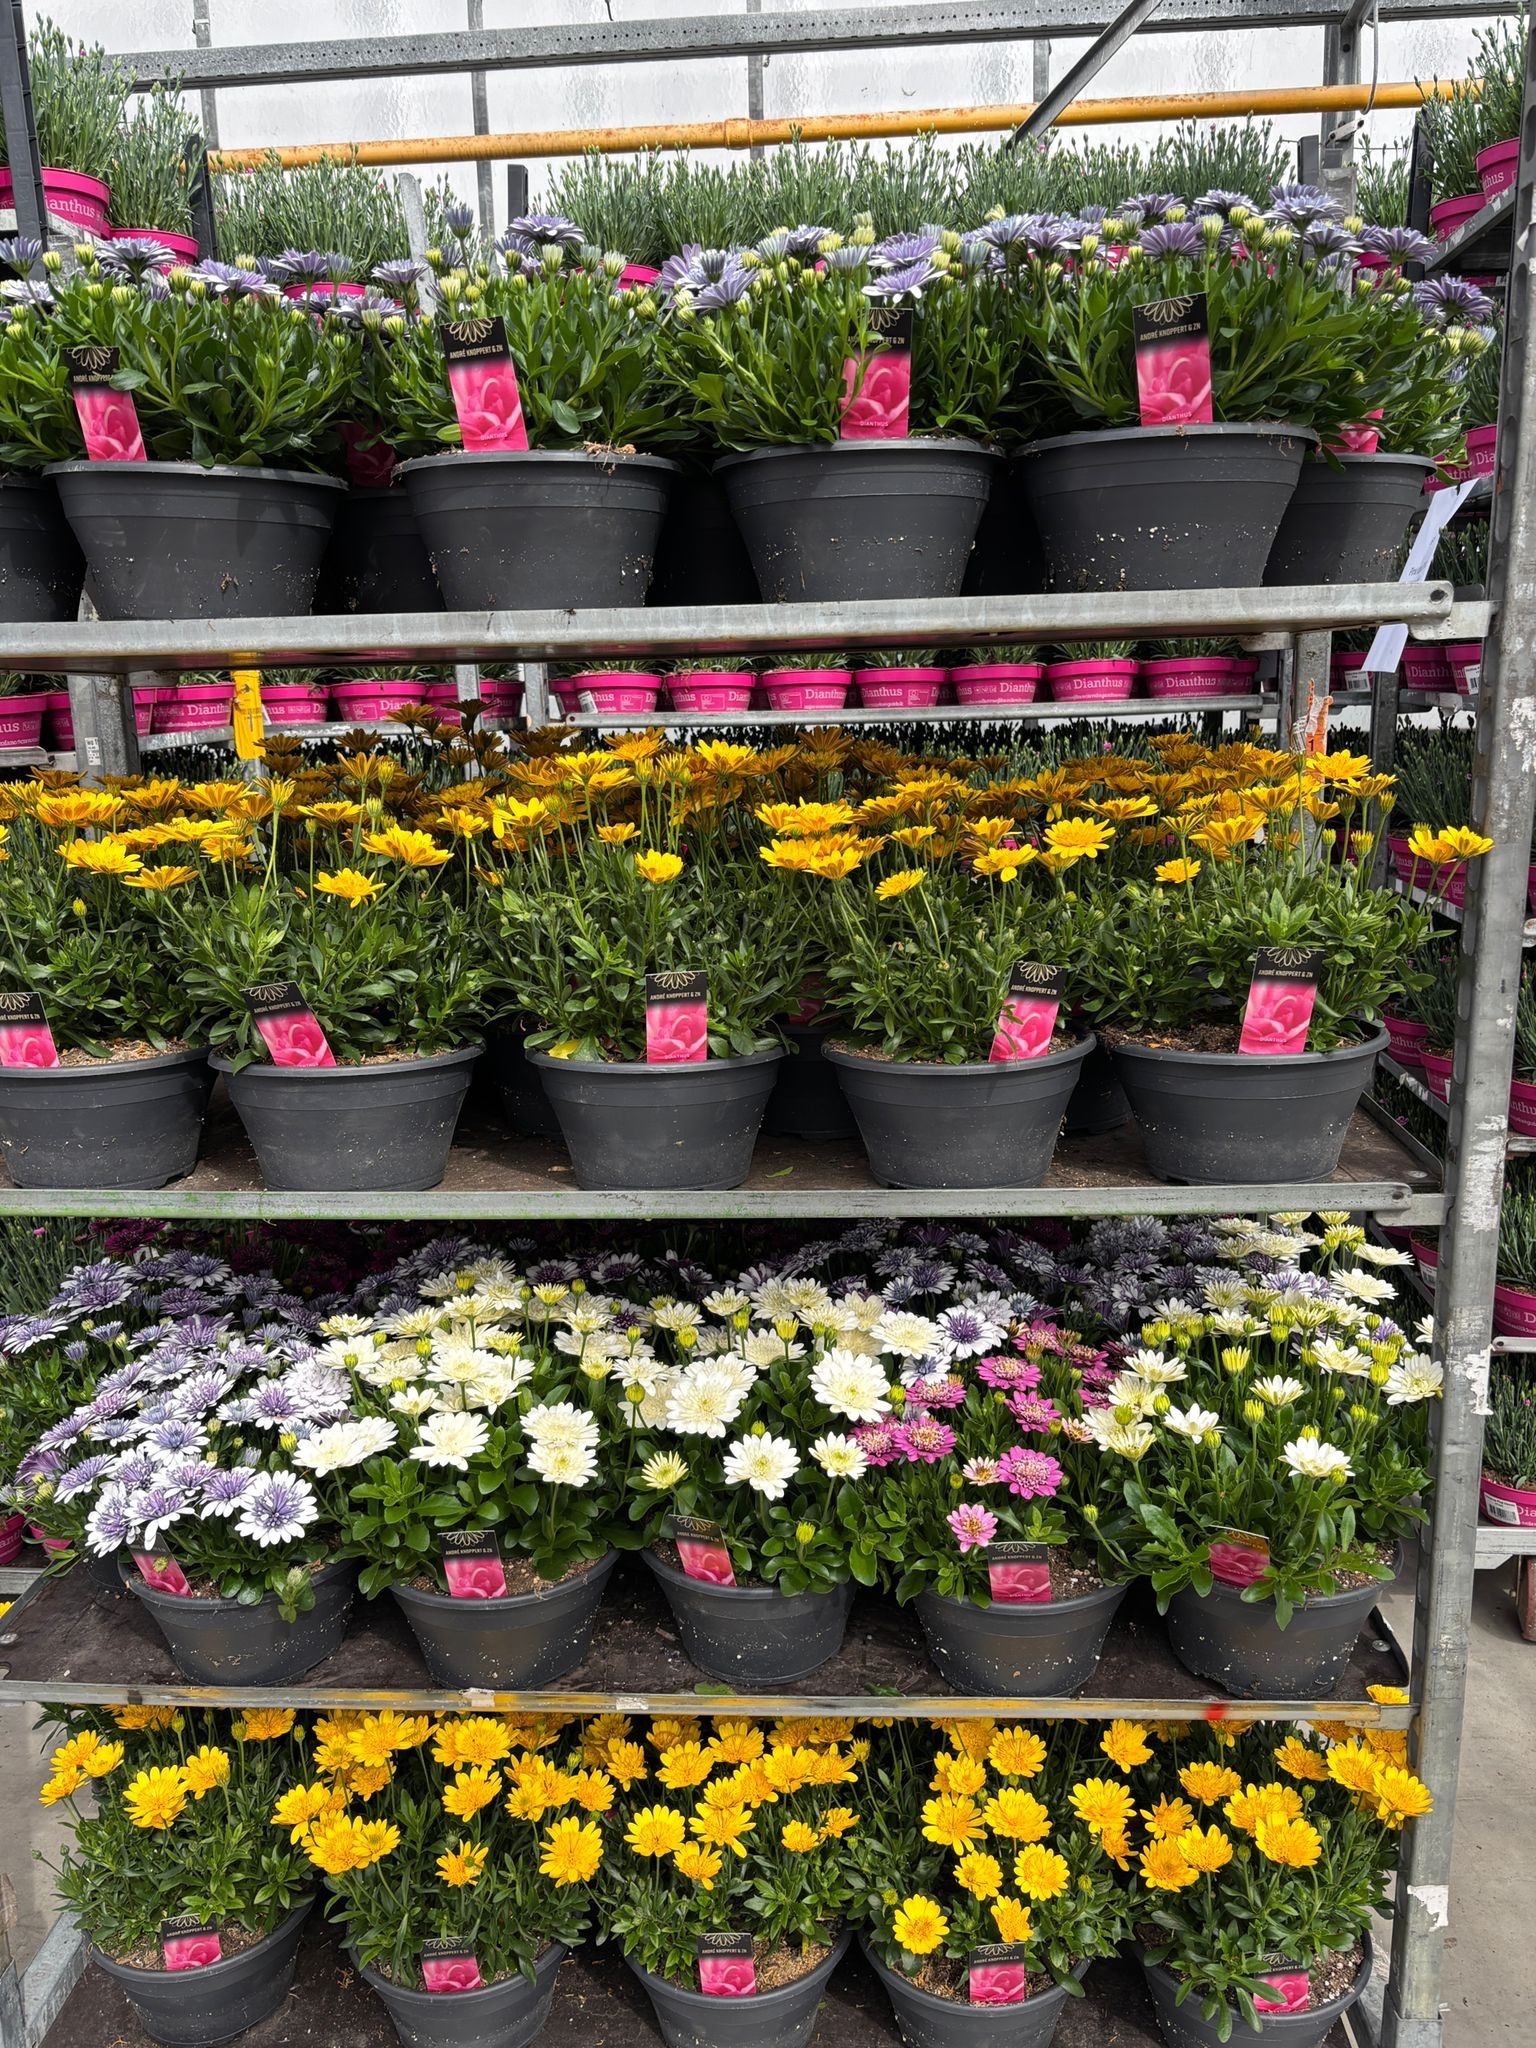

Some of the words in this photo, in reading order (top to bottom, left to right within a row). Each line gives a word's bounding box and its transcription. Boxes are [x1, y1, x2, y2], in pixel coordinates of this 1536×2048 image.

[45, 194, 95, 218] ianthus
[1140, 331, 1158, 342] ANDRÉ
[1159, 326, 1187, 338] KNOPPERT
[450, 350, 466, 359] ANDRÉ
[467, 346, 491, 357] KNOPPERT
[1161, 413, 1193, 422] DIANTHUS
[481, 431, 508, 441] DIANTHUS
[1000, 680, 1035, 693] Dianth
[1073, 677, 1123, 690] Dianthus
[1165, 675, 1217, 689] Dianthus
[1258, 969, 1275, 977] ANDRÉ
[1275, 970, 1301, 978] KNOPPERT
[1010, 984, 1024, 992] ANDRÉ
[1025, 986, 1046, 994] KNOPPERT
[650, 992, 665, 1000] ANDRÉ
[666, 992, 690, 1000] KNOPPERT
[270, 1003, 290, 1012] KNOPPERT
[8, 1013, 29, 1021] KNOPPERT
